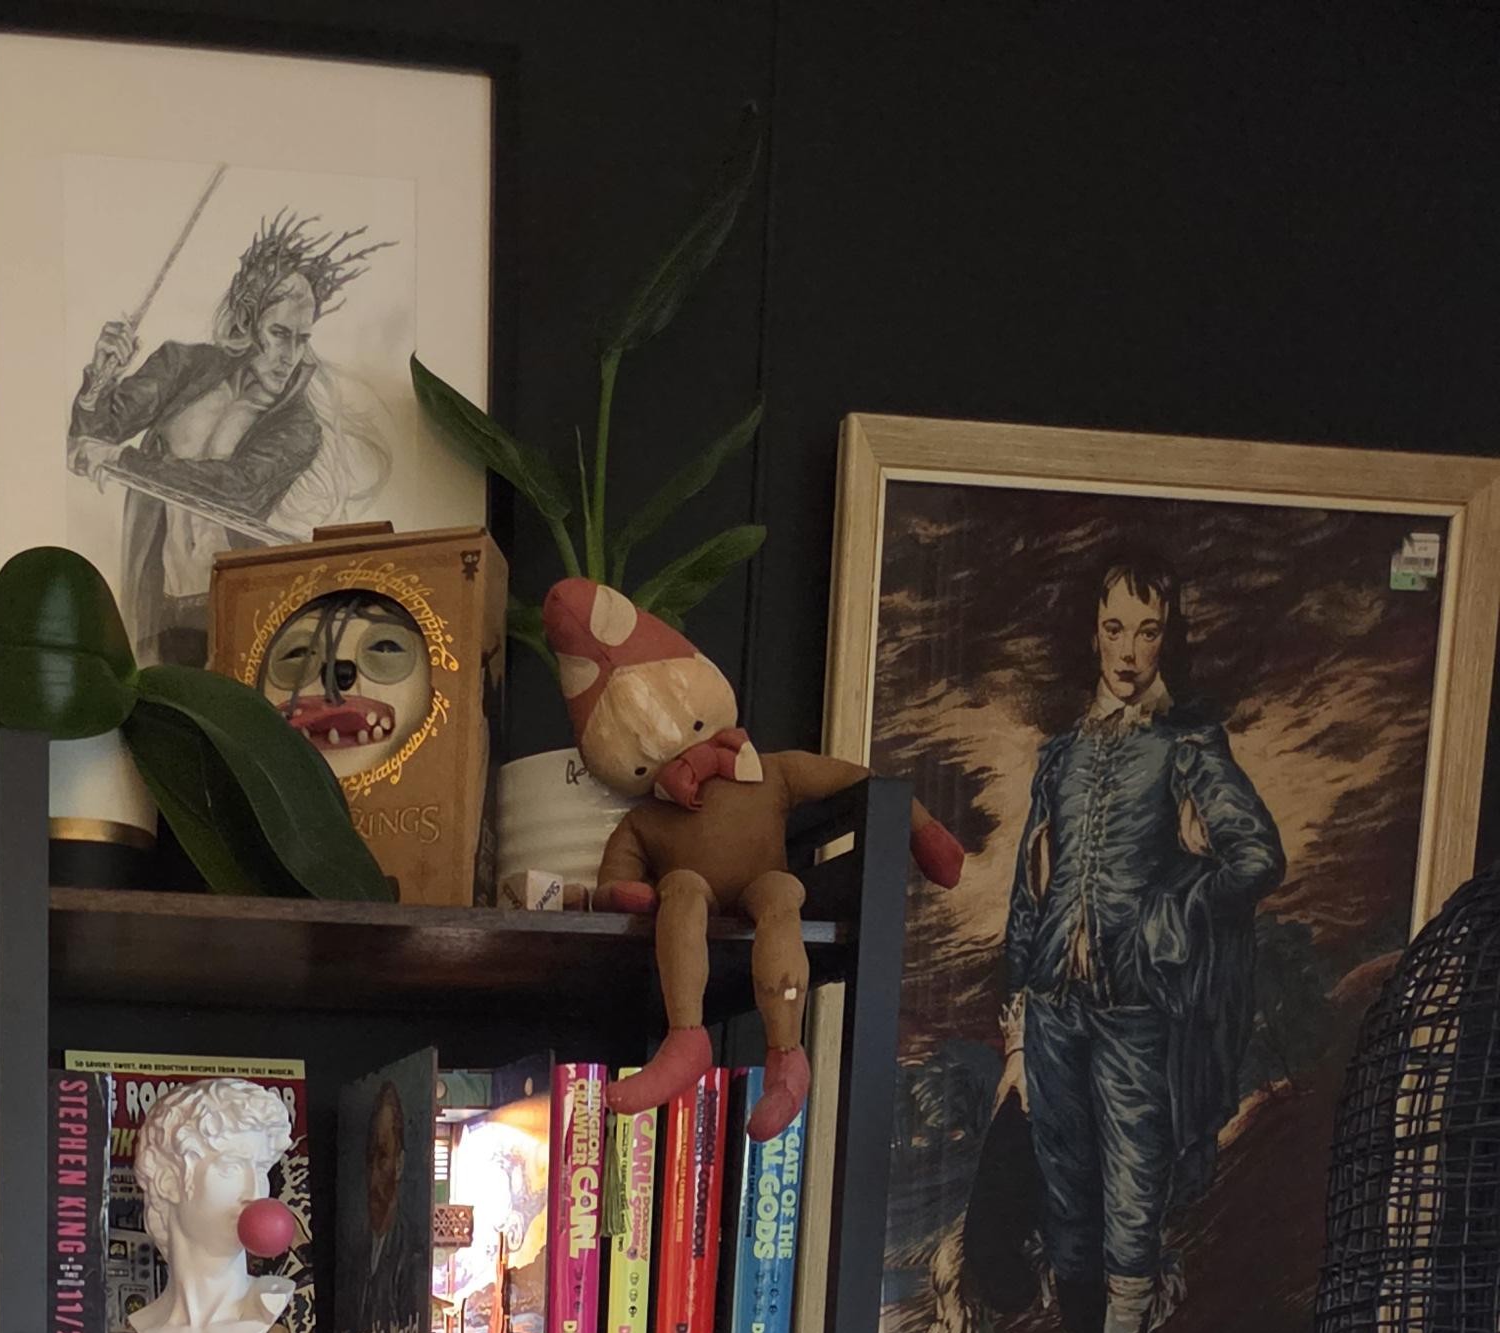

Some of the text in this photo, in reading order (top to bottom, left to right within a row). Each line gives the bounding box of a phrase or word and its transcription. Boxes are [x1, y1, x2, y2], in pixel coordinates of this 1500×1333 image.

[350, 806, 440, 844] RINGS
[58, 1079, 88, 1186] STEPHEN
[572, 1078, 588, 1166] CRAWLER
[587, 1079, 602, 1166] DUNGEON
[57, 1193, 87, 1254] KING
[568, 1167, 599, 1259] CARL
